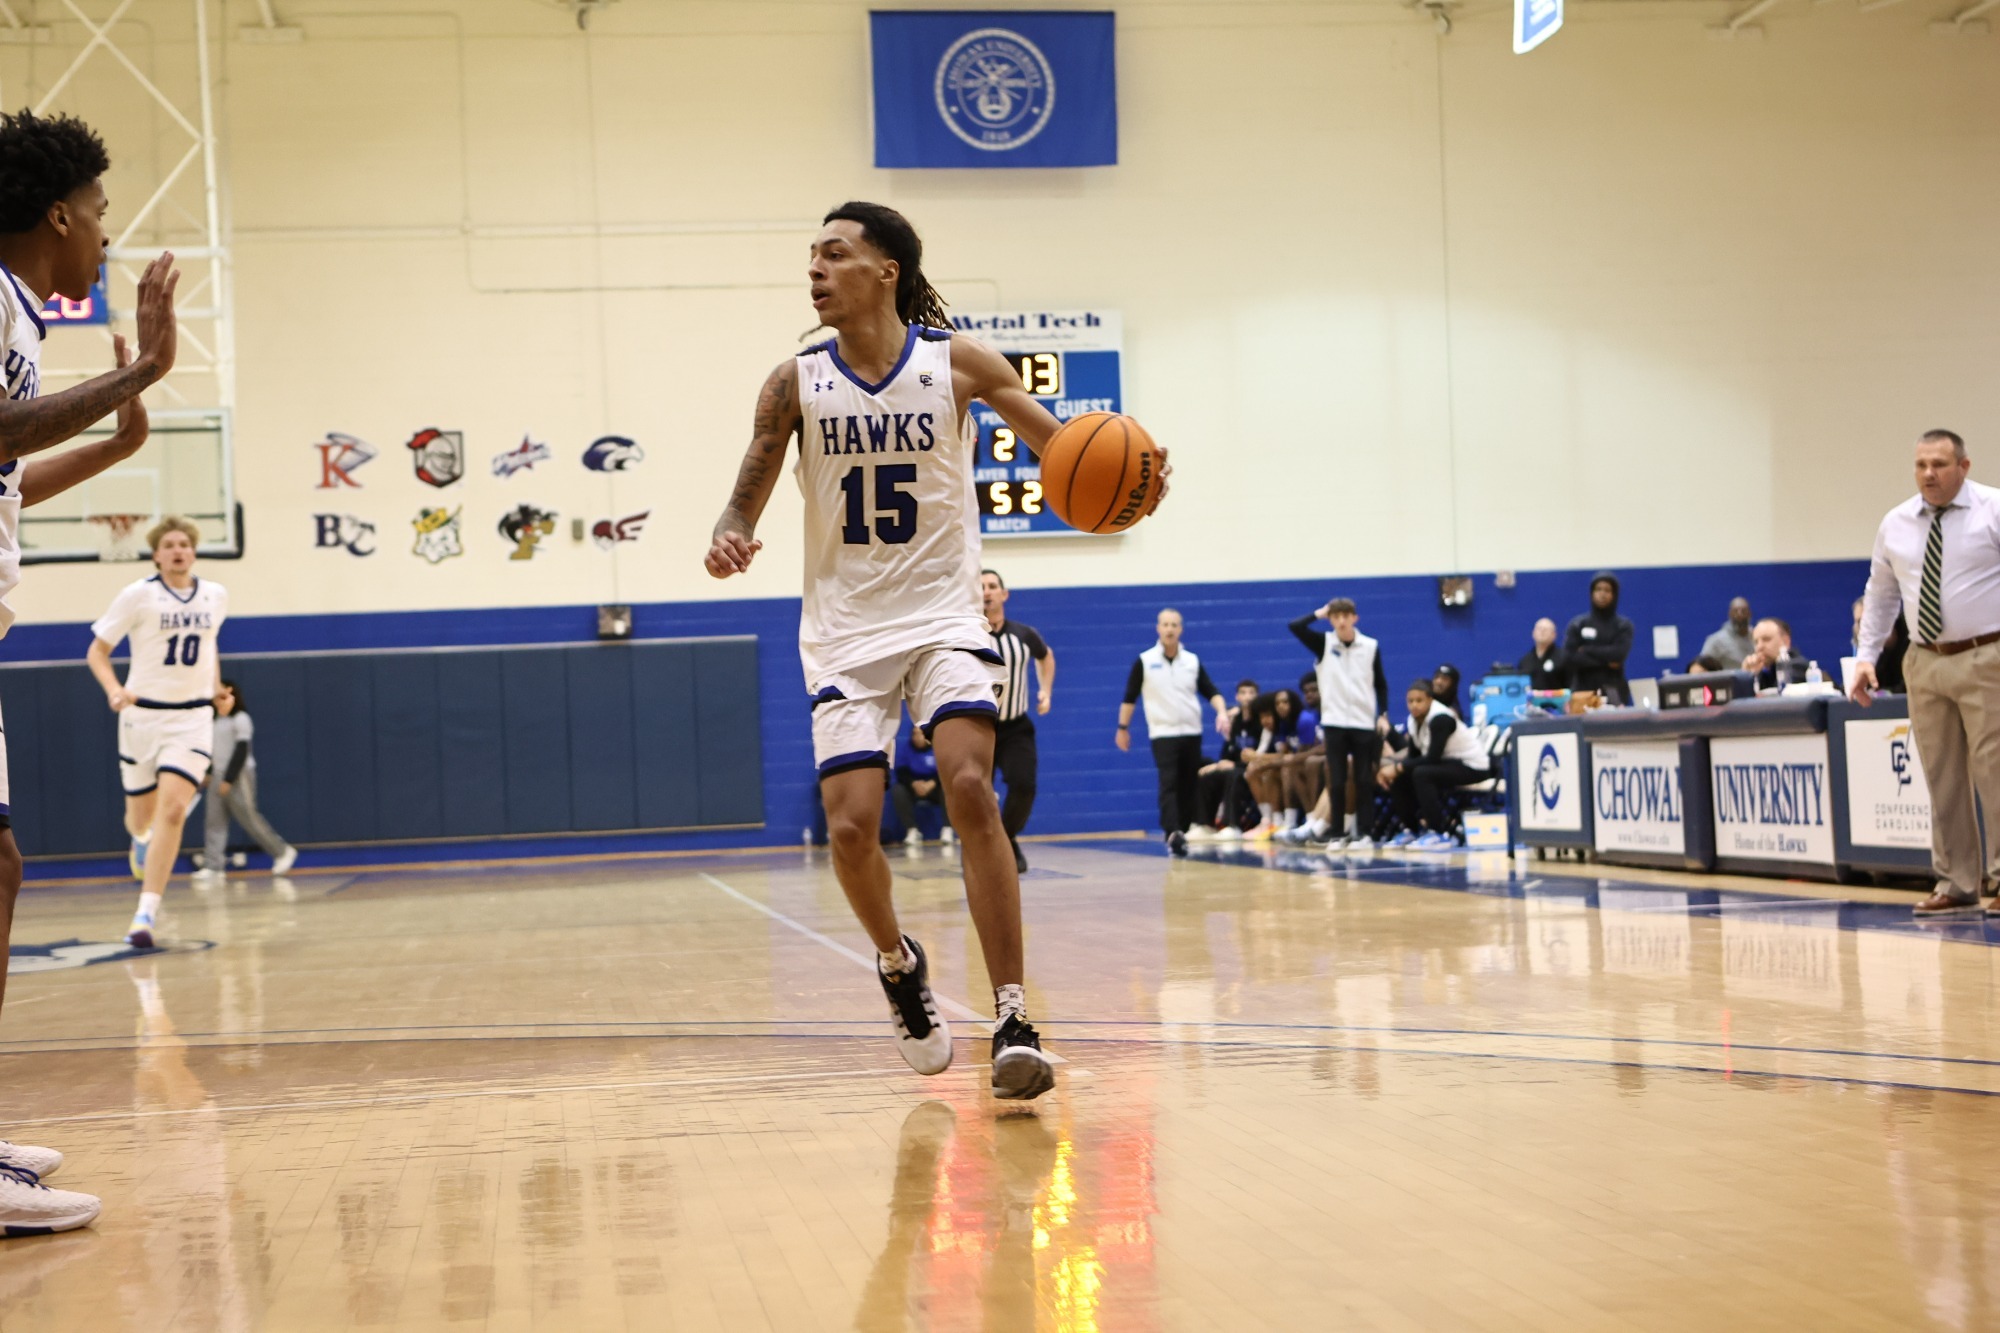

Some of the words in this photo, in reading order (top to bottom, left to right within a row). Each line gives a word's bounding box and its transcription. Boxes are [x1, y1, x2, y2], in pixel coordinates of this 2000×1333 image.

[951, 314, 1025, 330] Metal
[1033, 312, 1101, 328] Tech
[1022, 353, 1059, 395] 13
[1054, 398, 1113, 419] GUEST
[818, 412, 935, 455] HAWKS
[993, 428, 1015, 462] 2
[841, 463, 918, 545] 15
[1109, 451, 1151, 526] Wilson
[986, 518, 1030, 531] MATCH
[160, 612, 212, 630] HAWKS
[163, 633, 201, 667] 10
[1714, 763, 1824, 826] UNIVERSITY
[1875, 803, 1930, 816] CONFERENC
[1875, 818, 1930, 831] CAROLINA
